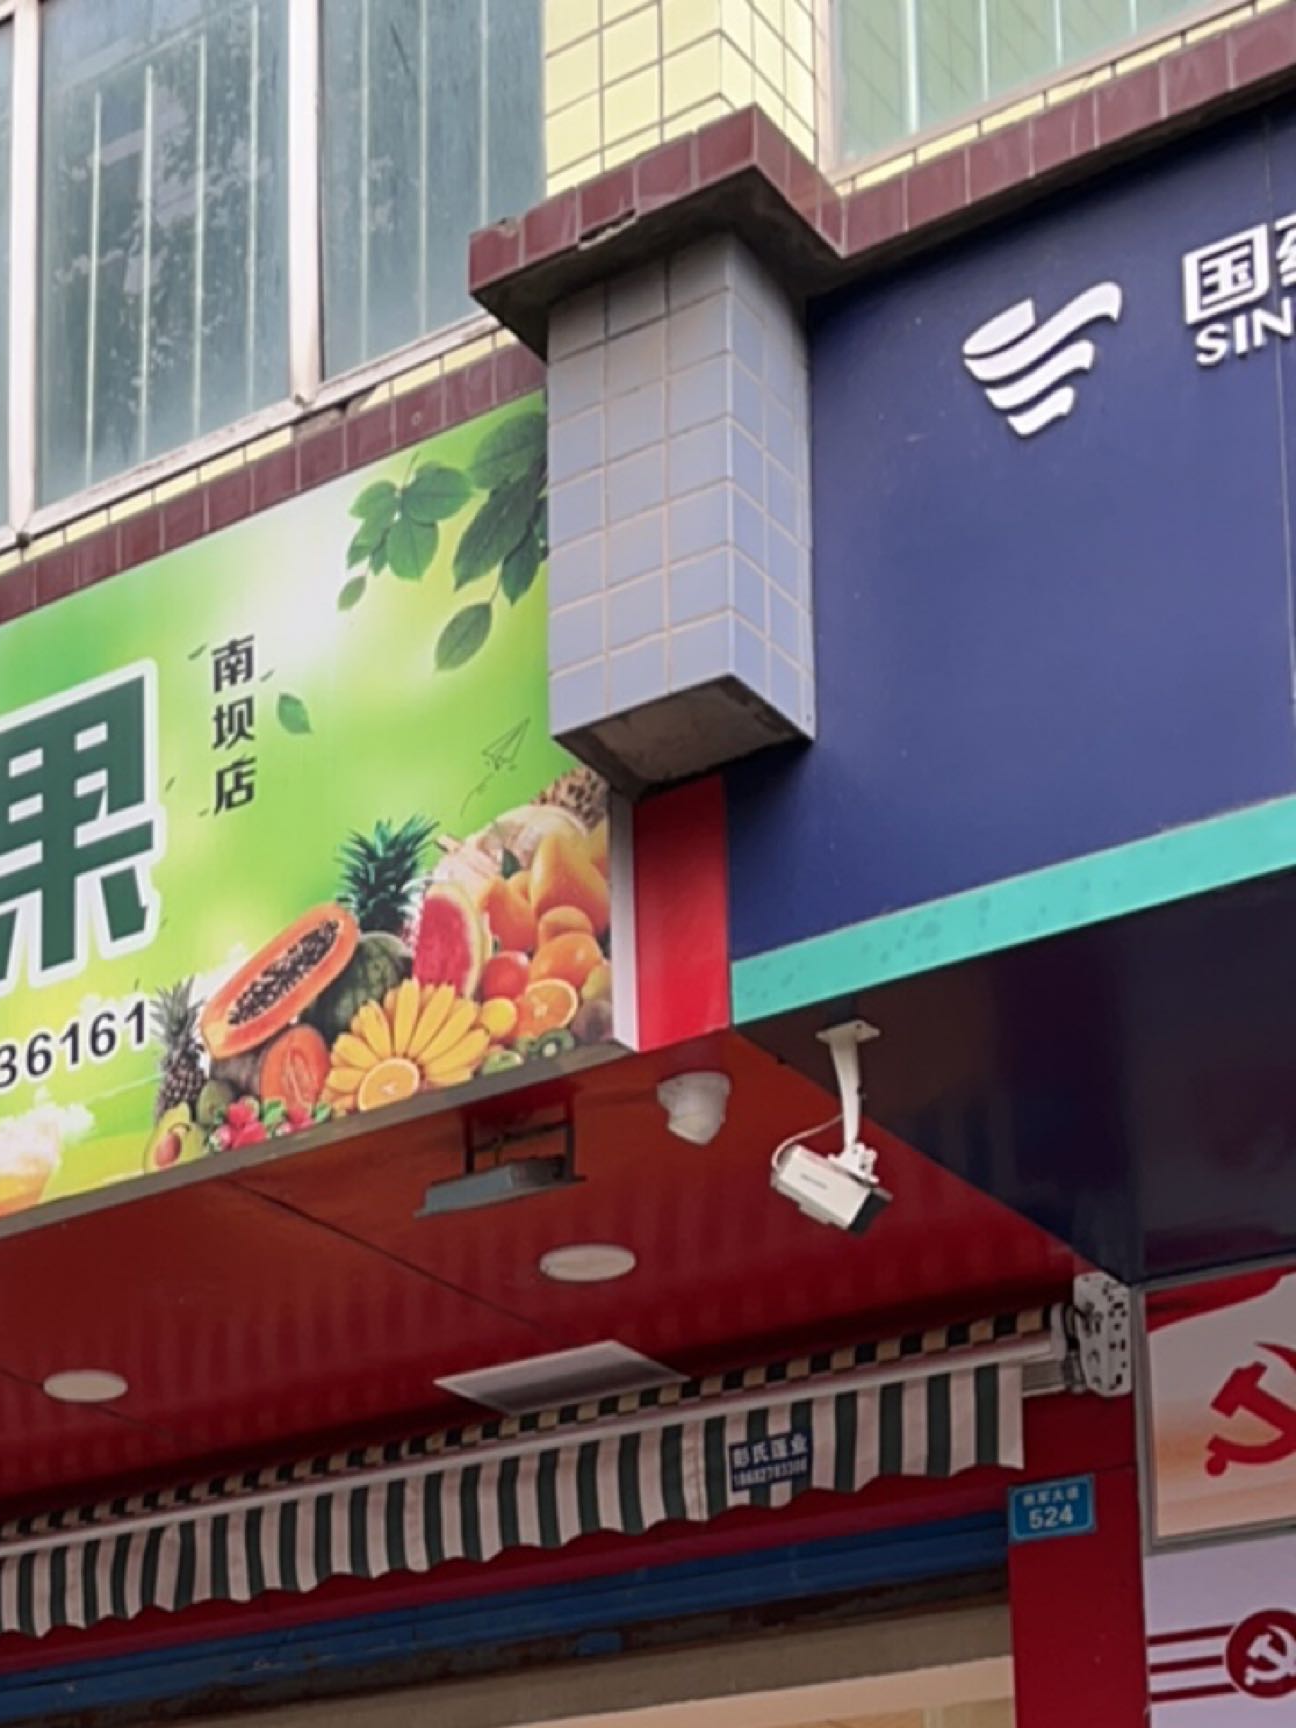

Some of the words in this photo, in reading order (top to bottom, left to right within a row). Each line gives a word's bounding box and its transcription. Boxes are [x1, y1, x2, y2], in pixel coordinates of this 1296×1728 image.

[212, 633, 256, 816] 南坝店
[1029, 1504, 1074, 1529] 524
